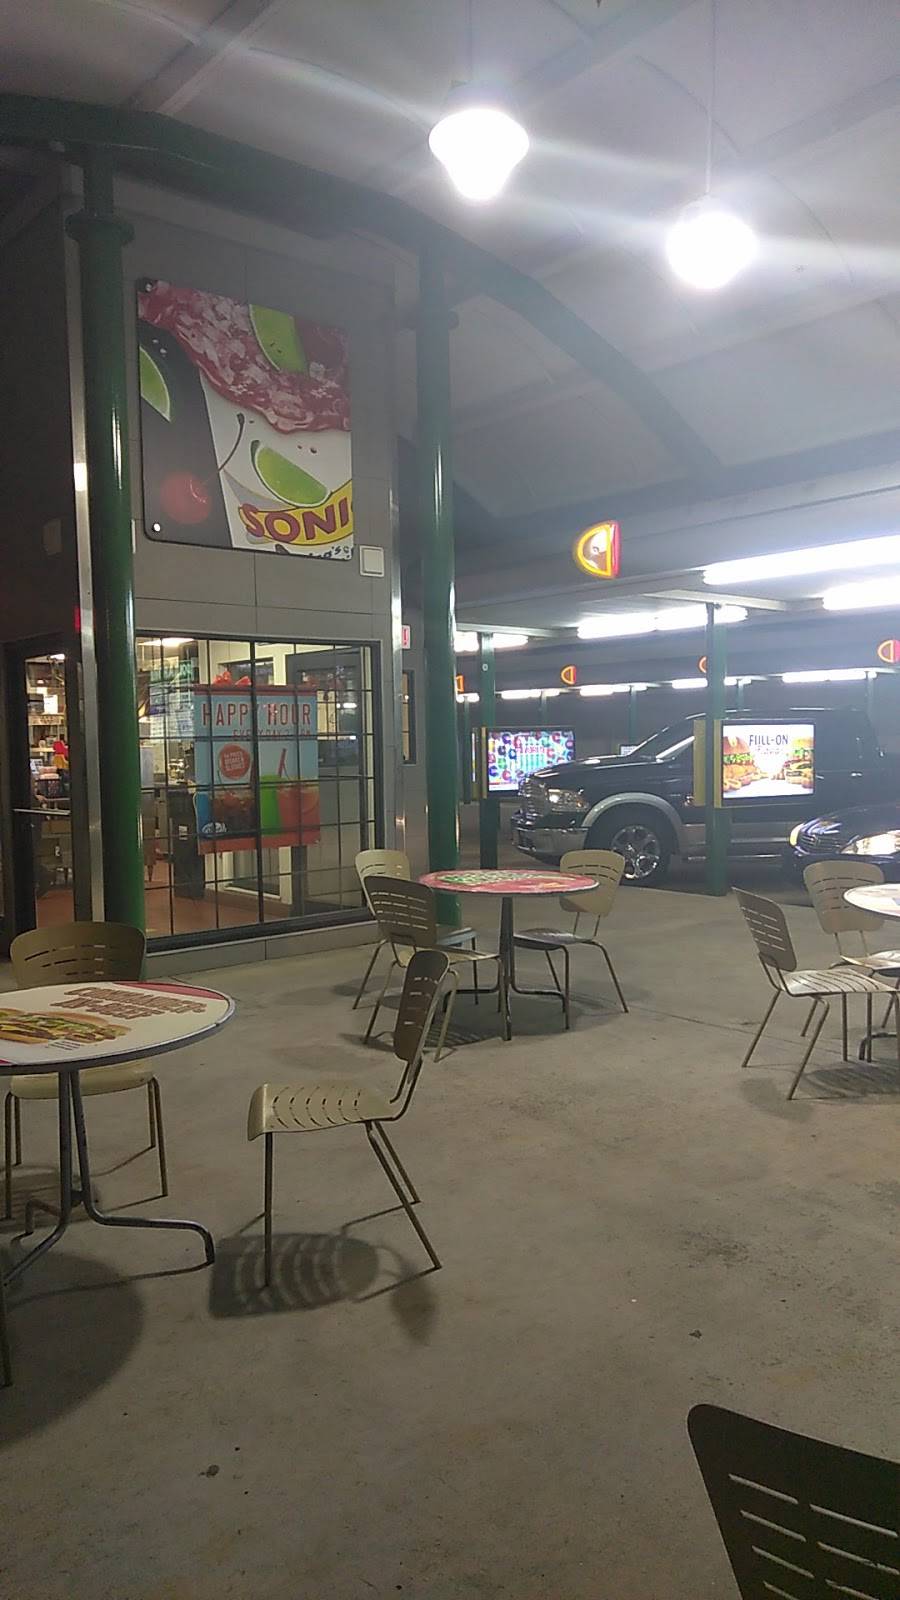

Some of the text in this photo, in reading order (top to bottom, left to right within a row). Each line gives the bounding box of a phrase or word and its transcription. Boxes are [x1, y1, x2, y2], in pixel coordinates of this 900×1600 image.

[240, 496, 352, 543] SONI
[202, 703, 259, 726] HAPP
[267, 703, 311, 726] HOUR
